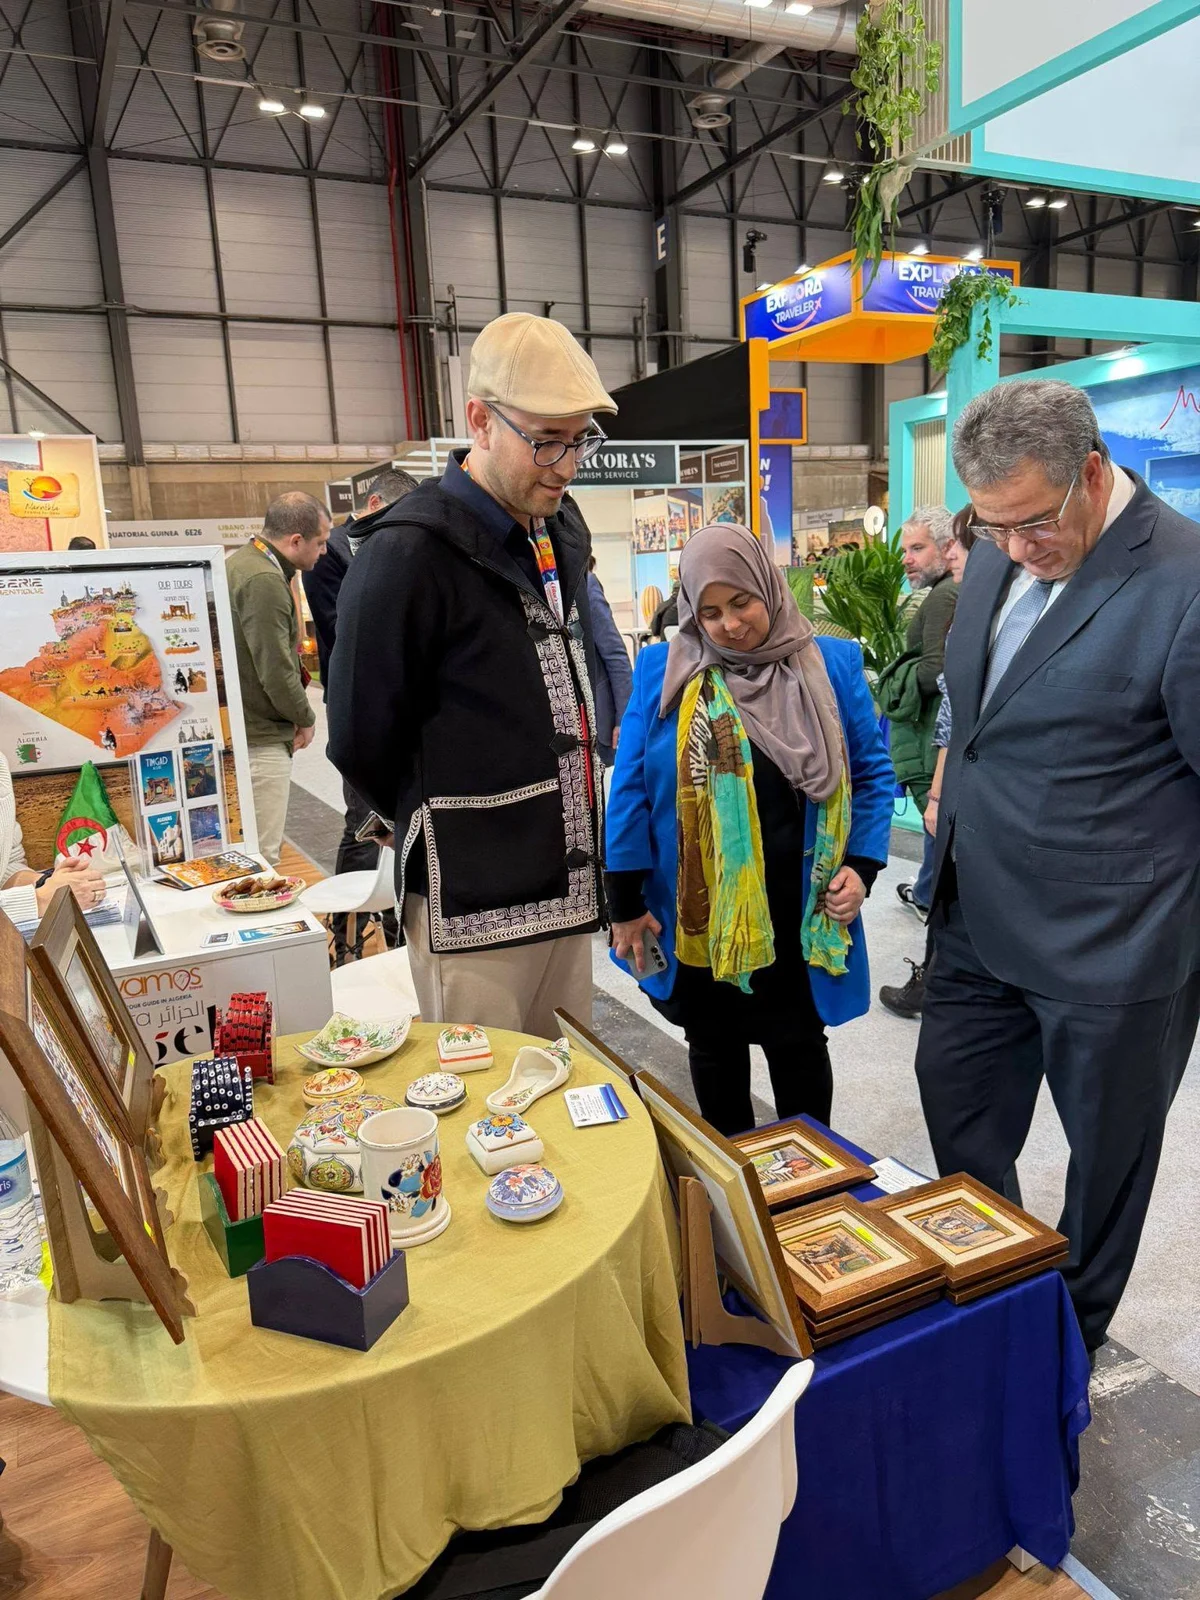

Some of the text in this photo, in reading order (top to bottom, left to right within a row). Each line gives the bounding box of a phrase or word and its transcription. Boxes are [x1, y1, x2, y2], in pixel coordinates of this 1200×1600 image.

[657, 223, 667, 260] E
[898, 263, 967, 284] EXPLO
[766, 276, 823, 313] EXPLORA
[775, 300, 814, 324] TRAVELER
[1160, 385, 1200, 430] M
[604, 471, 639, 479] SERVICES
[108, 530, 148, 539] QUATORIAL
[142, 999, 160, 1007] GUIDE
[168, 994, 193, 1003] ALGERIA
